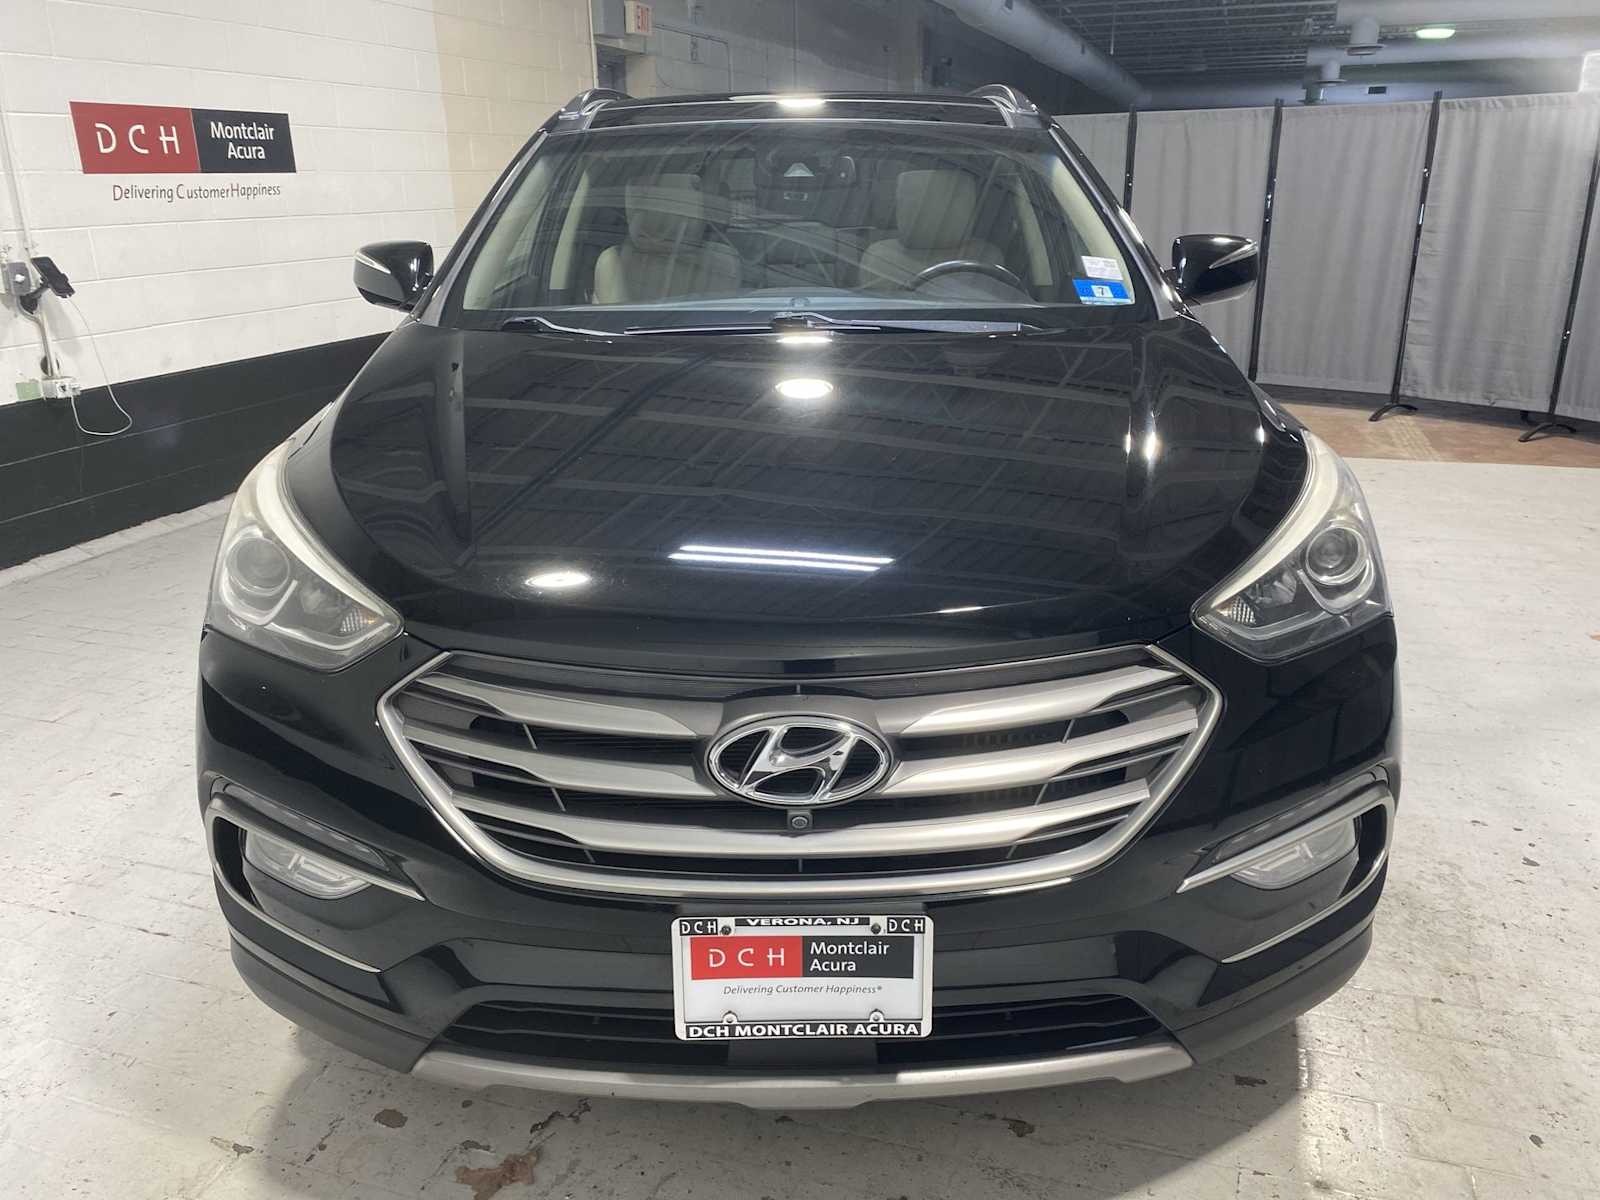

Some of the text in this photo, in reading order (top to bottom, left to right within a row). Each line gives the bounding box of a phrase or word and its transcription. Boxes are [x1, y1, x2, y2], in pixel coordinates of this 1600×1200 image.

[95, 122, 180, 154] DCH
[210, 121, 275, 140] Montclair
[227, 142, 266, 159] Acura
[113, 184, 174, 203] Delivering
[681, 921, 717, 934] DCH
[836, 917, 860, 925] NJ
[888, 919, 924, 932] DCH
[810, 941, 890, 955] Montclair
[708, 948, 785, 968] DCH
[810, 958, 857, 972] Acura
[723, 985, 773, 996] Delivering
[775, 984, 824, 994] Customer
[689, 1022, 919, 1038] DCH MONTCLAIR ACURA
